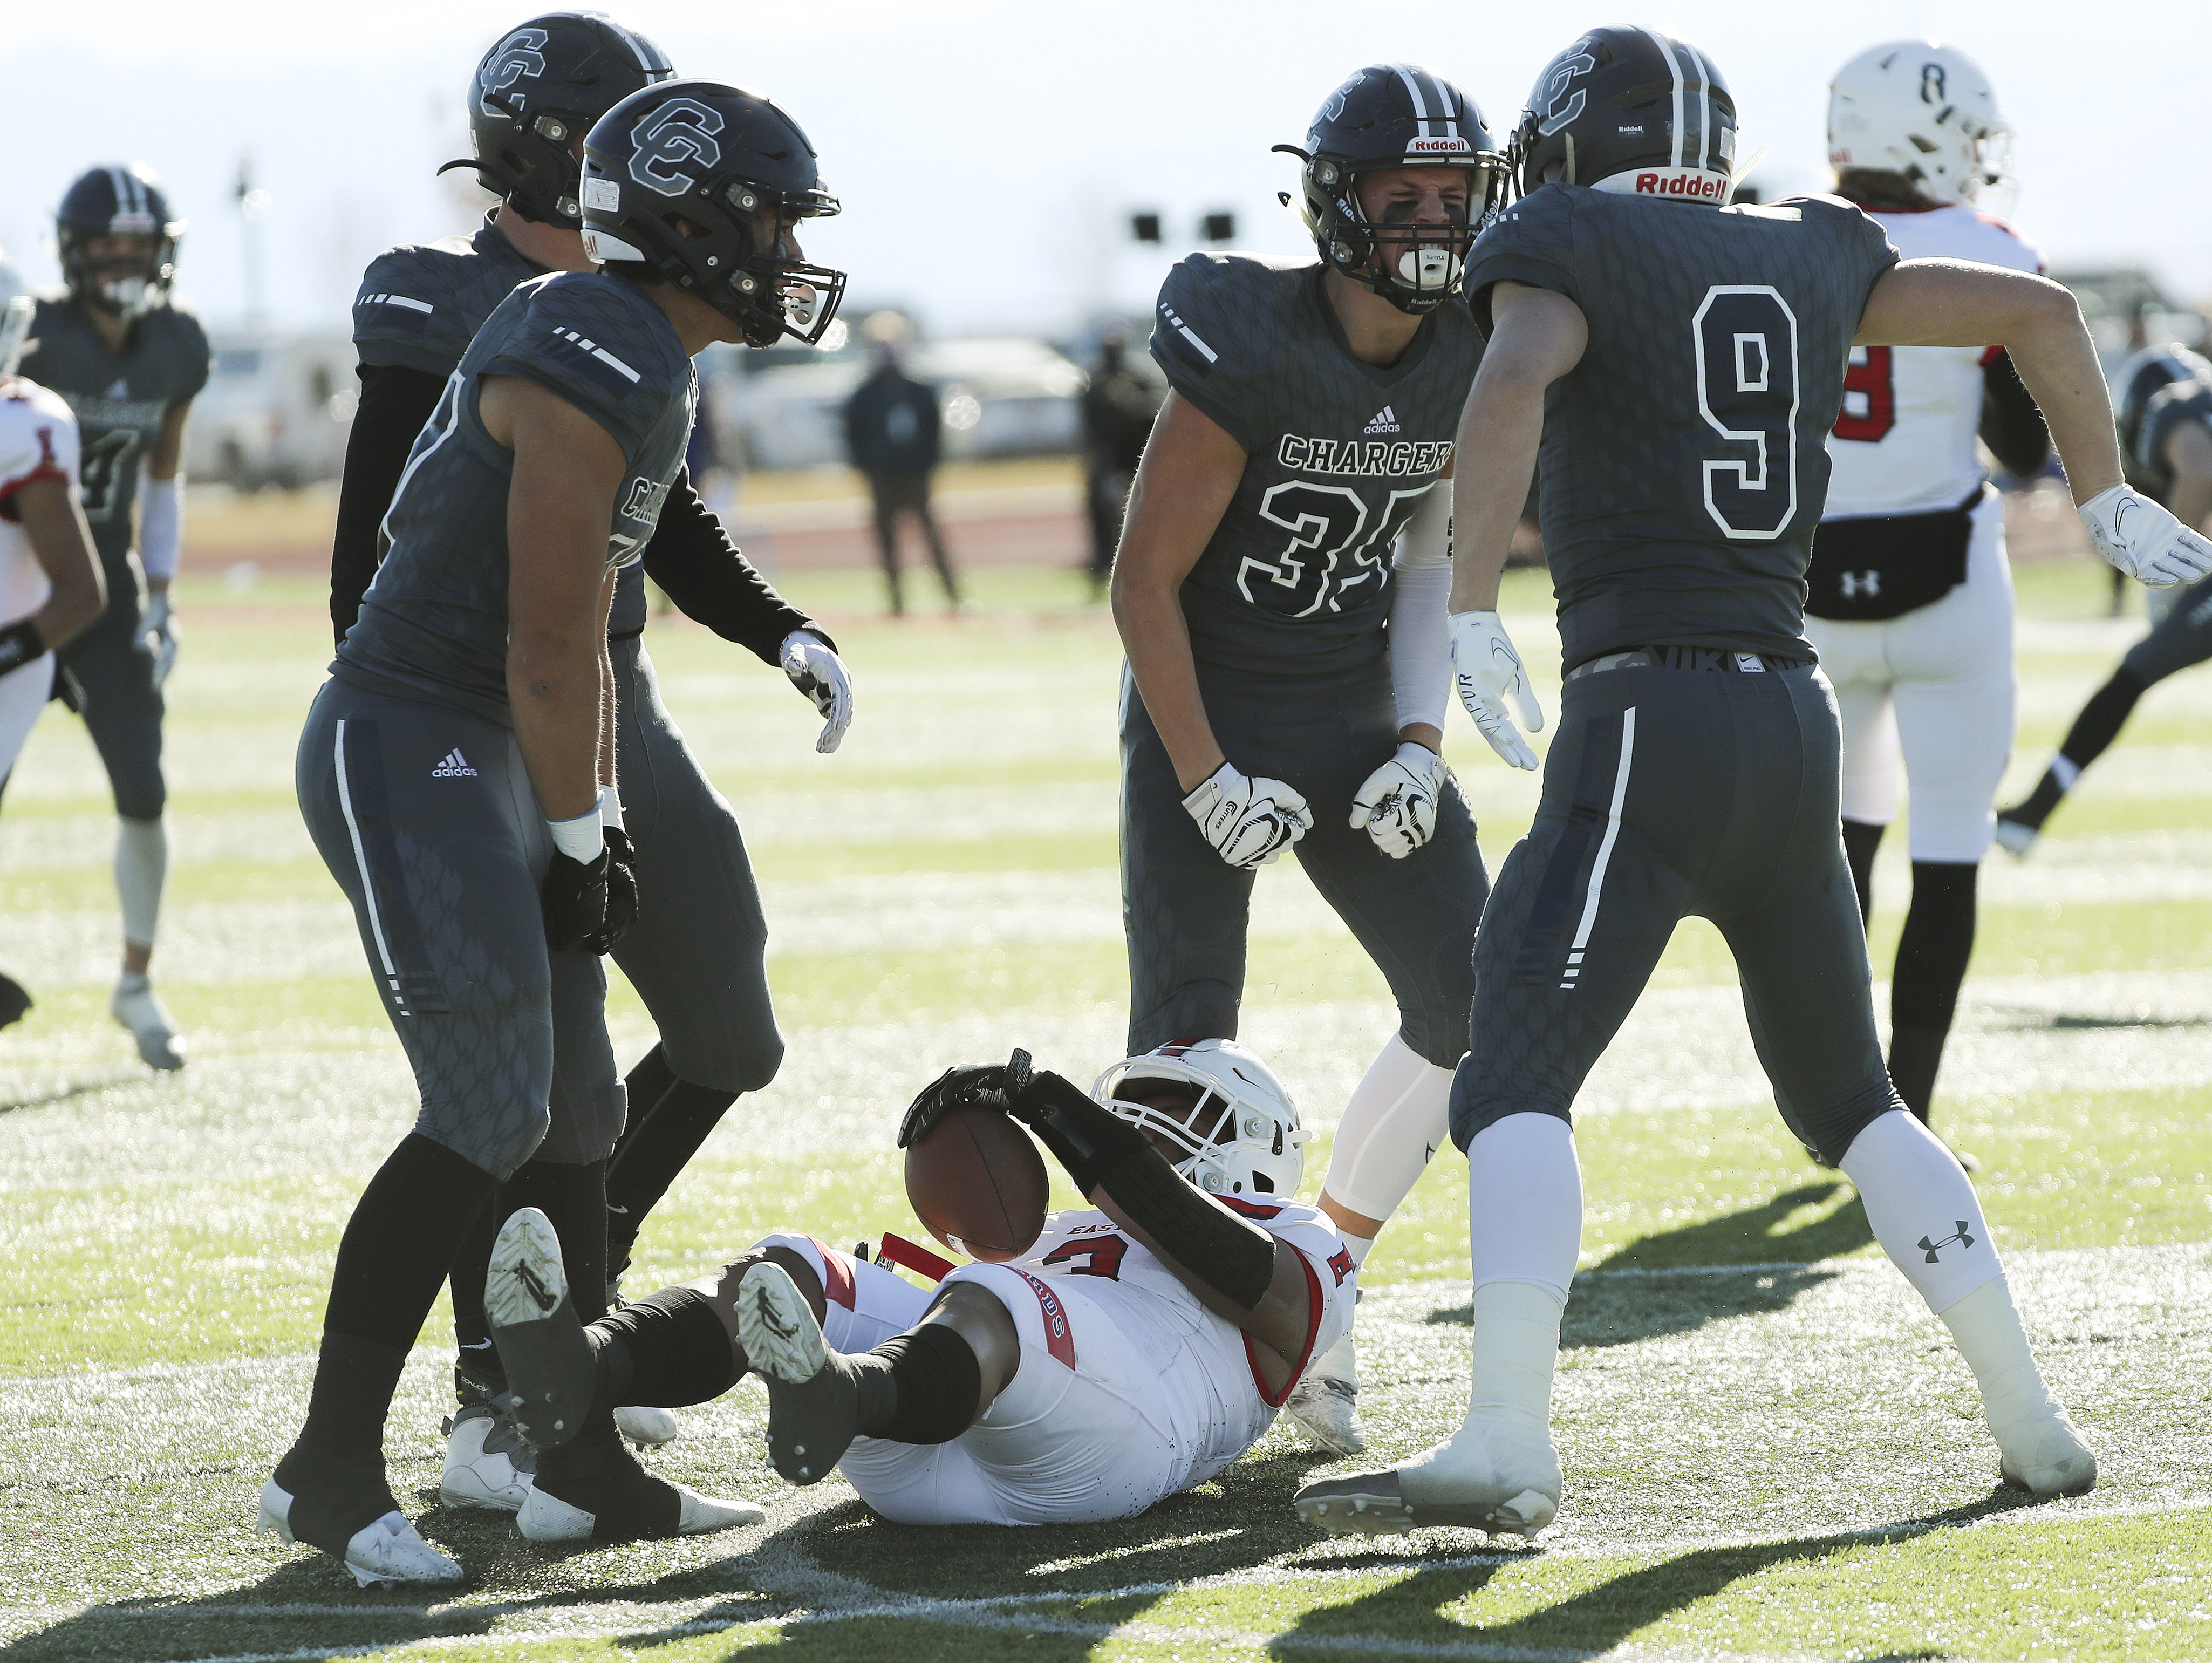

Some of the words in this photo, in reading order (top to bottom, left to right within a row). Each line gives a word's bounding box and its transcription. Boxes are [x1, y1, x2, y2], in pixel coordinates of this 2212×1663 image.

[628, 98, 725, 197] CC
[1415, 140, 1465, 151] Riddell
[1636, 173, 1727, 200] Riddell
[1692, 285, 1800, 540] 9
[1363, 422, 1401, 434] adidas
[1277, 433, 1456, 476] CHARGER
[432, 766, 477, 778] adidas
[1215, 800, 1238, 829] CUTTERS
